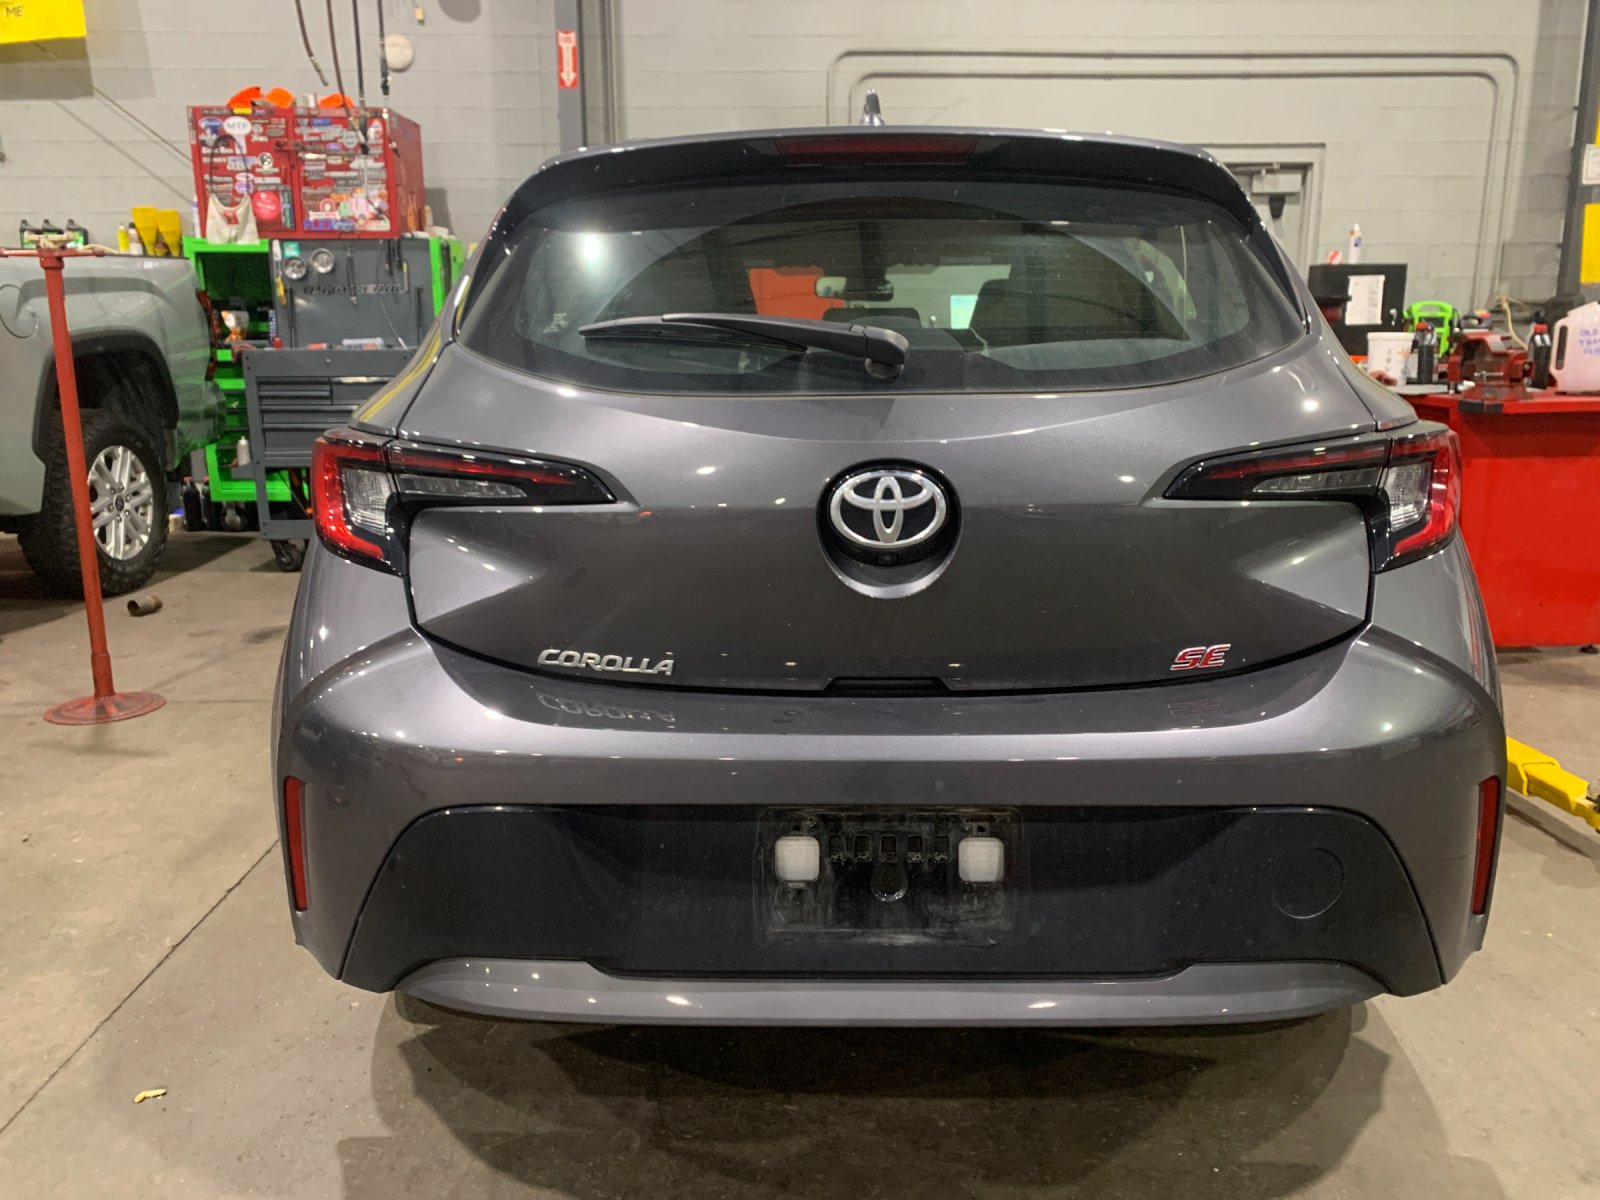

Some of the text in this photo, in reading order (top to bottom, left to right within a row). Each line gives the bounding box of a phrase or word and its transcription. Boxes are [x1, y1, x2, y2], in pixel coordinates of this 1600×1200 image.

[1580, 328, 1599, 337] OLD
[537, 649, 675, 676] COROLLA
[1170, 644, 1231, 671] SE
